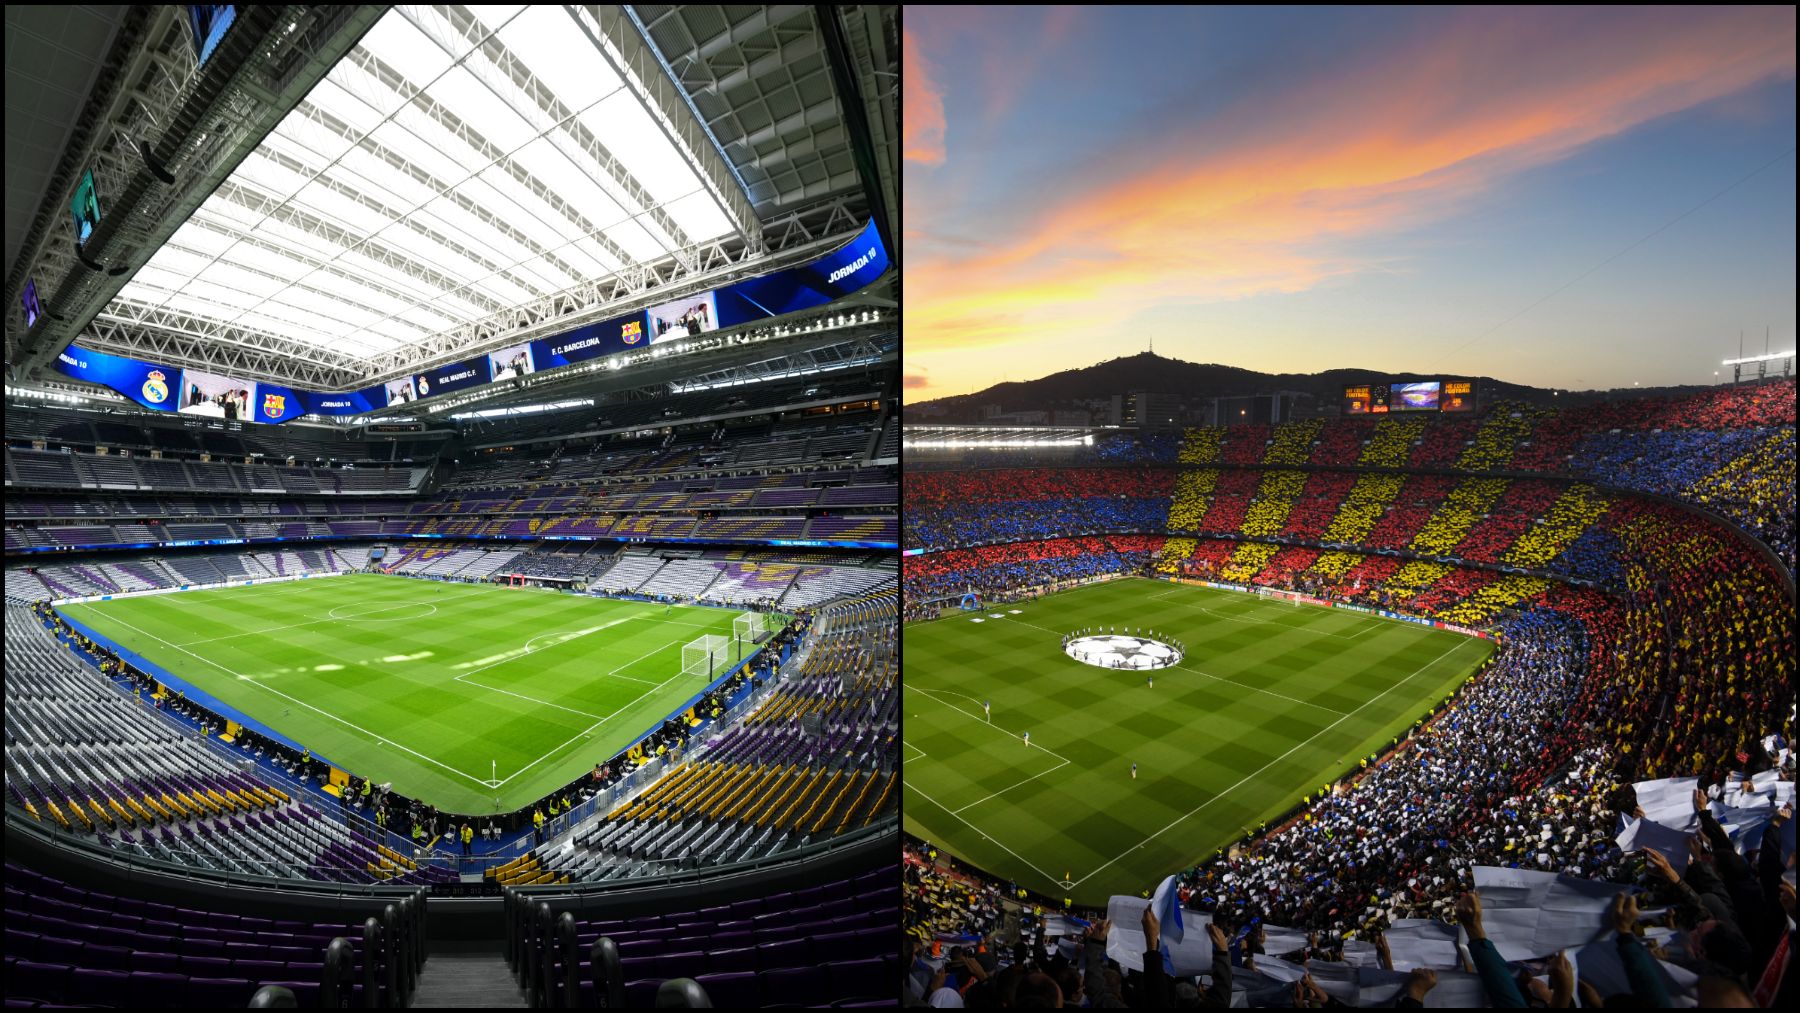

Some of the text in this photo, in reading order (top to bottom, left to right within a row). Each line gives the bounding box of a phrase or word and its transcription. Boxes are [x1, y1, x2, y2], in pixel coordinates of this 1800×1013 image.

[828, 247, 877, 283] JORNADA 10
[563, 337, 600, 352] BARCELONA
[79, 361, 87, 369] 10
[439, 376, 450, 384] REAL
[1399, 614, 1421, 624] PS4
[1444, 623, 1479, 637] NISSAN
